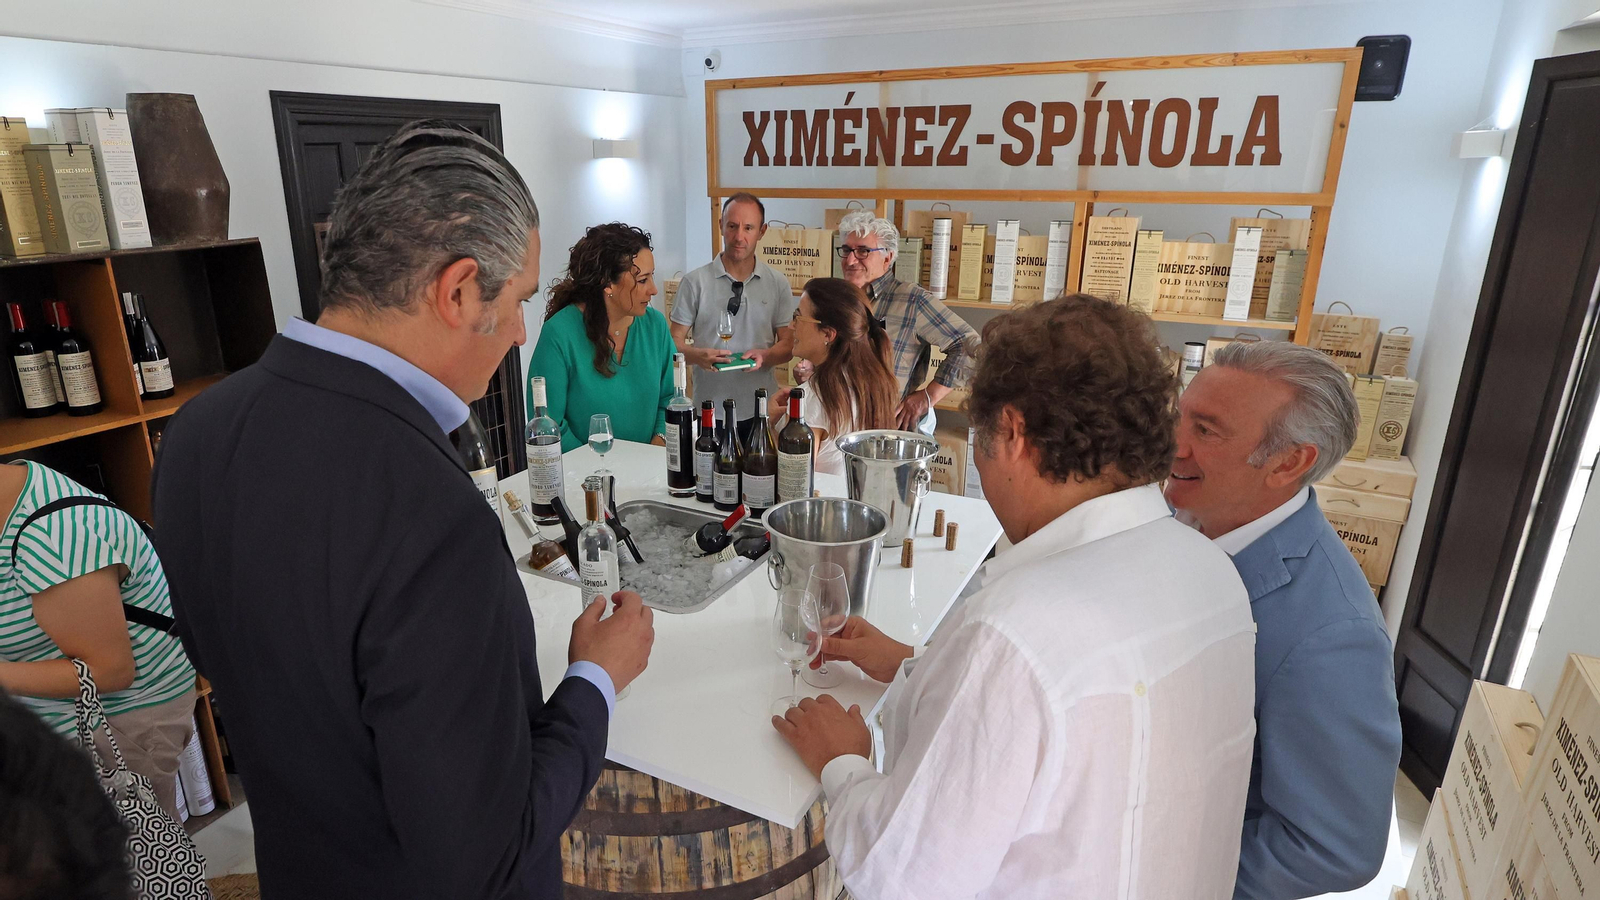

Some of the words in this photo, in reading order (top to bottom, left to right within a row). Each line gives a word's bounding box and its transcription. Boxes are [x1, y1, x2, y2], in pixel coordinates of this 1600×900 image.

[742, 80, 1282, 168] XIMÉNEZ-SPÍNOLA
[762, 244, 820, 258] XIMÉNEZ-SPÍNOLA
[784, 259, 816, 268] HARVEST
[1016, 270, 1043, 278] RVEST
[1159, 277, 1181, 287] OLD
[1586, 735, 1600, 765] FINES
[1555, 717, 1600, 824] XIMÉNEZ-SPÍN
[1460, 761, 1470, 788] OLD
[1468, 785, 1488, 841] HARVEST
[1551, 757, 1568, 793] OLD
[1566, 790, 1600, 866] HARVEST
[1561, 812, 1574, 840] FROM
[1540, 792, 1553, 820] JEREZ
[1551, 817, 1560, 833] DE
[1556, 831, 1564, 846] LA
[1562, 841, 1586, 897] FRONTERA
